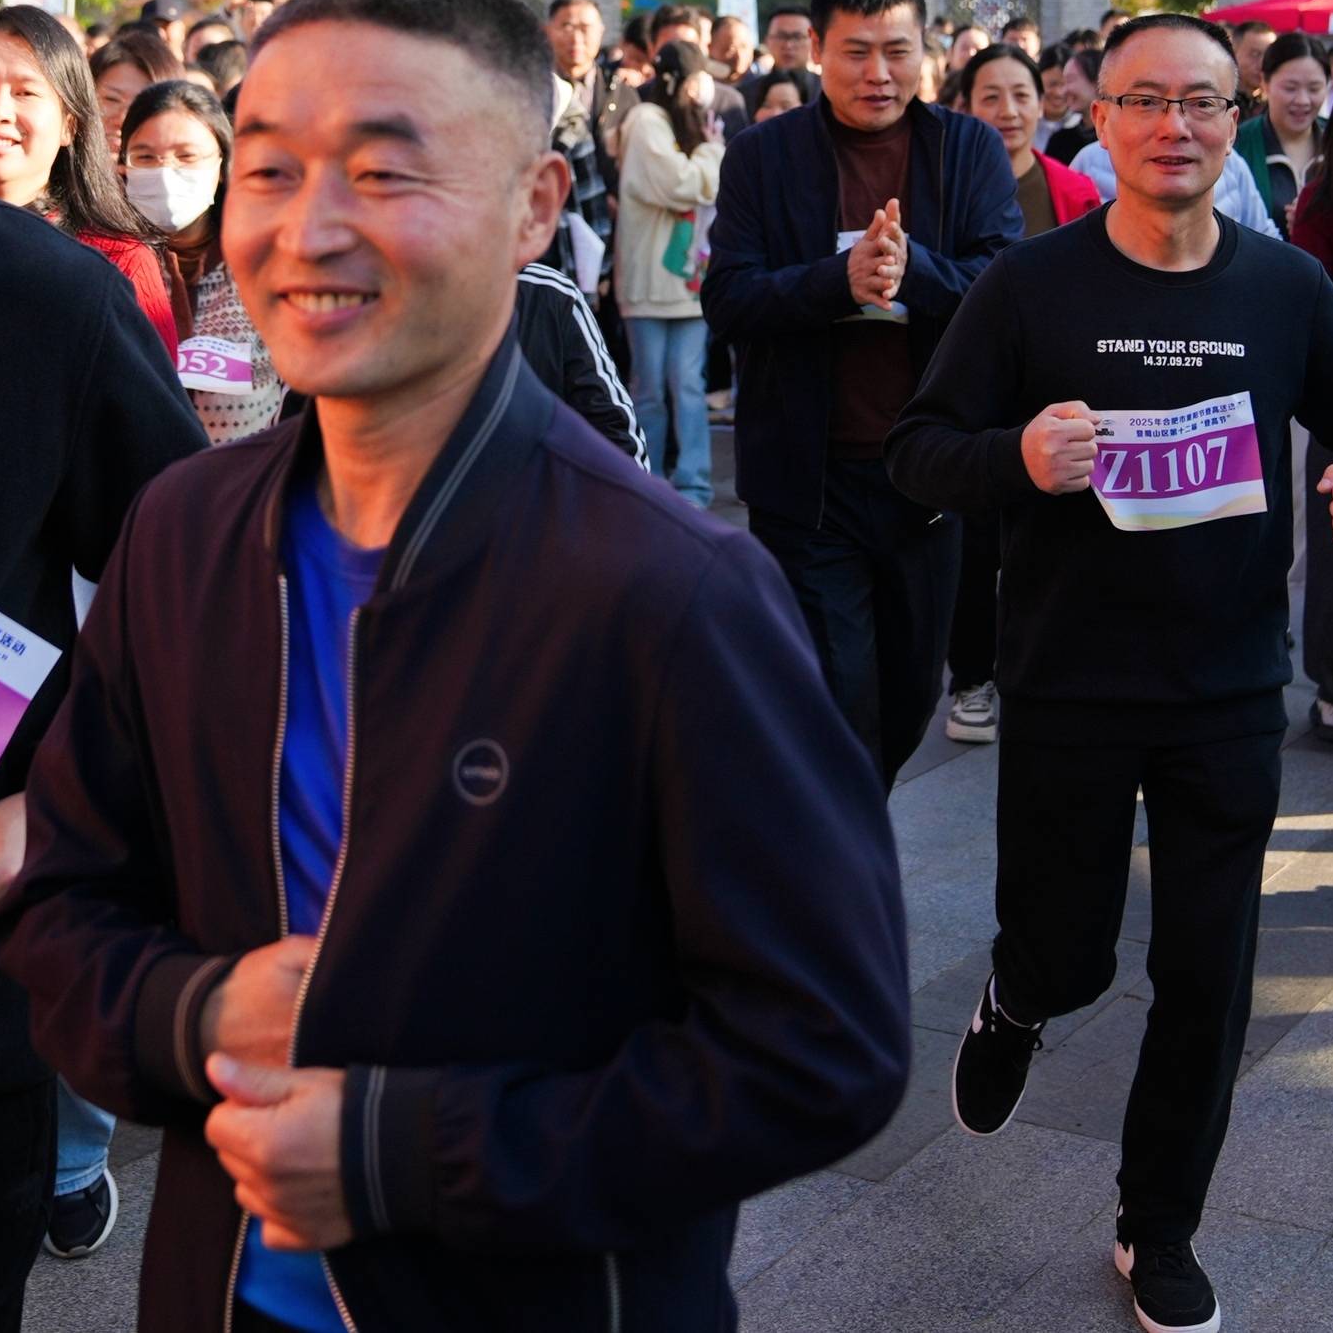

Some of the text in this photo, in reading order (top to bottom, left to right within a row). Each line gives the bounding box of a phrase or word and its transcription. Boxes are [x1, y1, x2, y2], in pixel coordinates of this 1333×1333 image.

[1097, 339, 1246, 358] STAND YOUR GROUND
[1143, 355, 1203, 367] 14.37.09.276
[1100, 435, 1228, 493] Z1107
